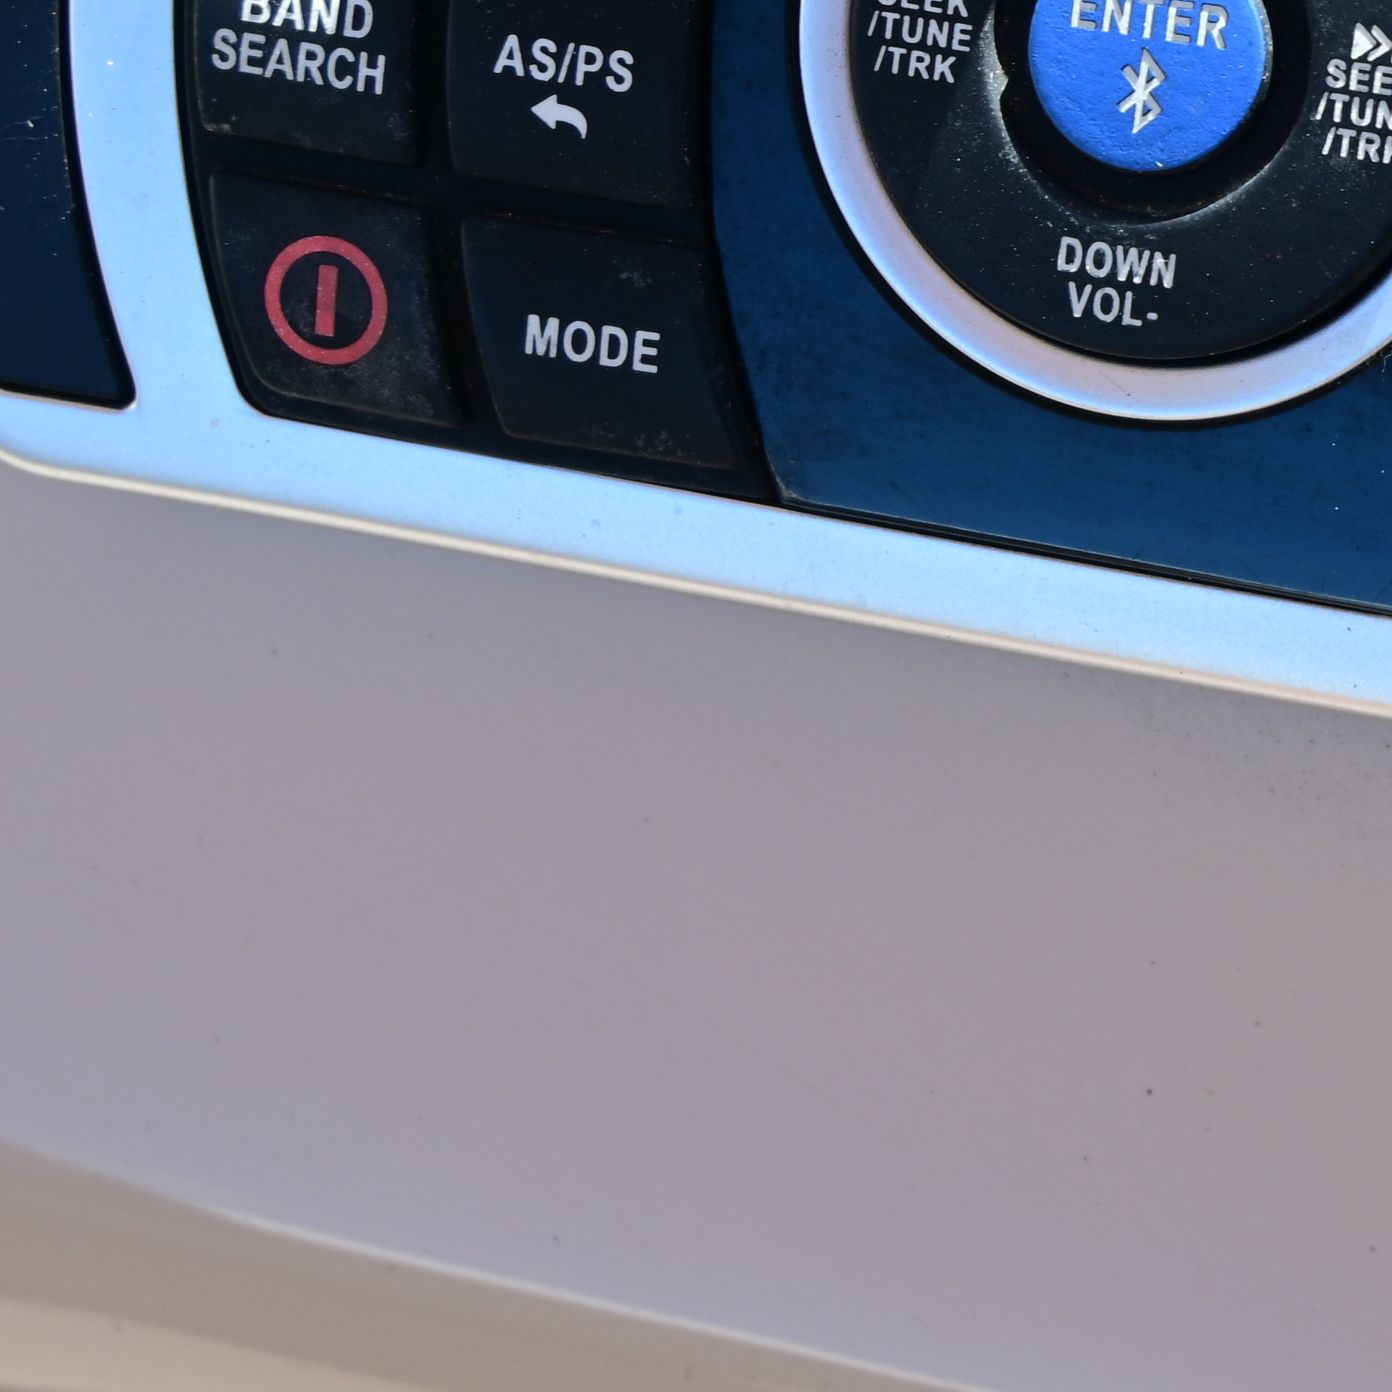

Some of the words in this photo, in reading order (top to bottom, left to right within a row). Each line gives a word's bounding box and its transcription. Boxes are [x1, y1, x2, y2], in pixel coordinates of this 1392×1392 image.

[867, 10, 974, 52] /TUNE
[211, 28, 387, 96] SEARCH
[494, 35, 633, 92] AS/PS
[873, 45, 957, 84] /TRK
[1056, 236, 1177, 289] DOWN
[1068, 281, 1159, 327] VOL-
[525, 315, 660, 373] MODE
